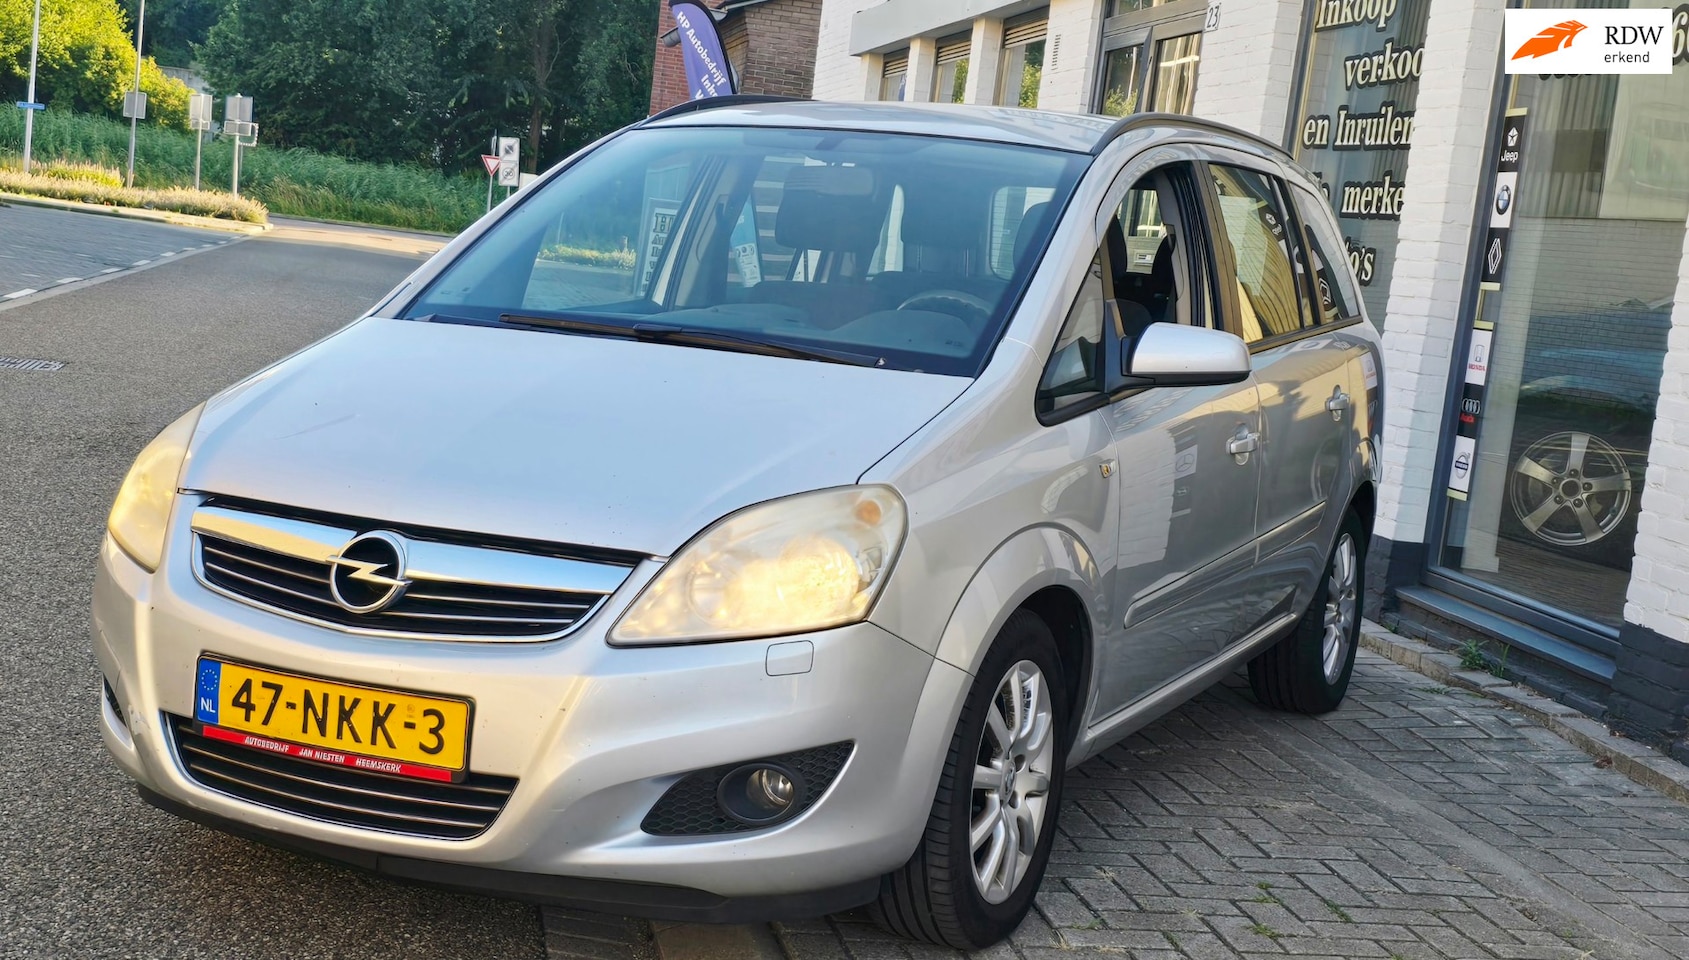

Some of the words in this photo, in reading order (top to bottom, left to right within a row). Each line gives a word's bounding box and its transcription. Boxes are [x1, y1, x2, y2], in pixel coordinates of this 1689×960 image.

[1206, 7, 1219, 28] 23
[1316, 0, 1396, 29] Inkoop
[677, 11, 690, 29] HP
[686, 28, 727, 86] Autobedrijf
[1303, 119, 1330, 146] en
[1501, 150, 1518, 163] Jeep
[201, 698, 216, 714] NL
[231, 677, 446, 755] 47-NKK-3
[244, 735, 290, 753] AUTOBEDRIJF
[299, 747, 313, 757] JAN
[314, 749, 346, 763] NIESTEN
[355, 757, 402, 773] HEEMSKERK
